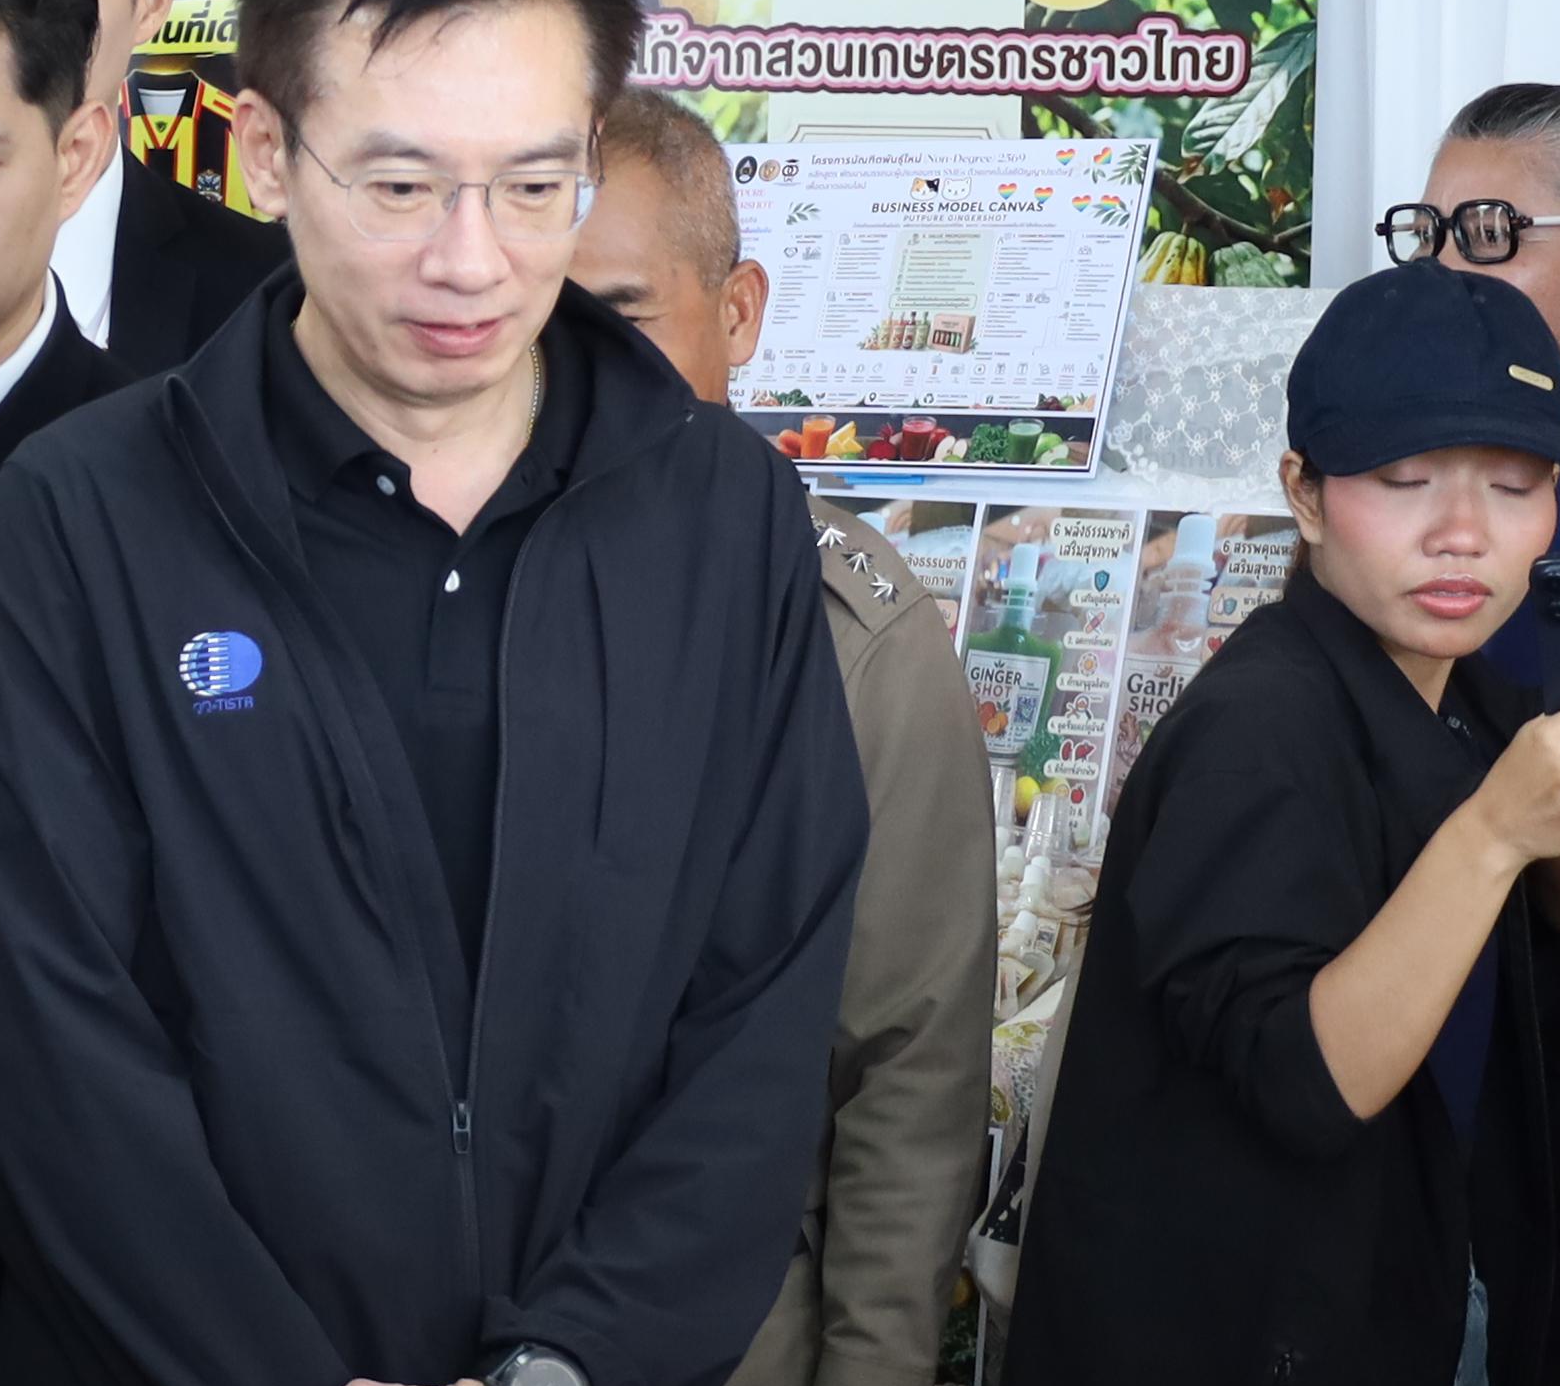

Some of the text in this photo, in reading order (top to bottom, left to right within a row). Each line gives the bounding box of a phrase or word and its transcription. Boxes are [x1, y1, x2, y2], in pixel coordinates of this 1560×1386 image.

[871, 201, 1044, 213] BUSINESS MODEL CANVAS
[902, 213, 1007, 222] PUTPURE GINGERSHOT
[1054, 519, 1130, 543] 6 พลังธรรมชาติ
[1058, 543, 1120, 563] เสริมสุขภาพ
[1222, 540, 1230, 554] 6
[1228, 560, 1287, 580] เสริมสุขภา
[970, 666, 1022, 686] GINGER
[1126, 672, 1184, 699] Garli
[974, 682, 1013, 699] SHOT
[1128, 696, 1172, 715] SHO
